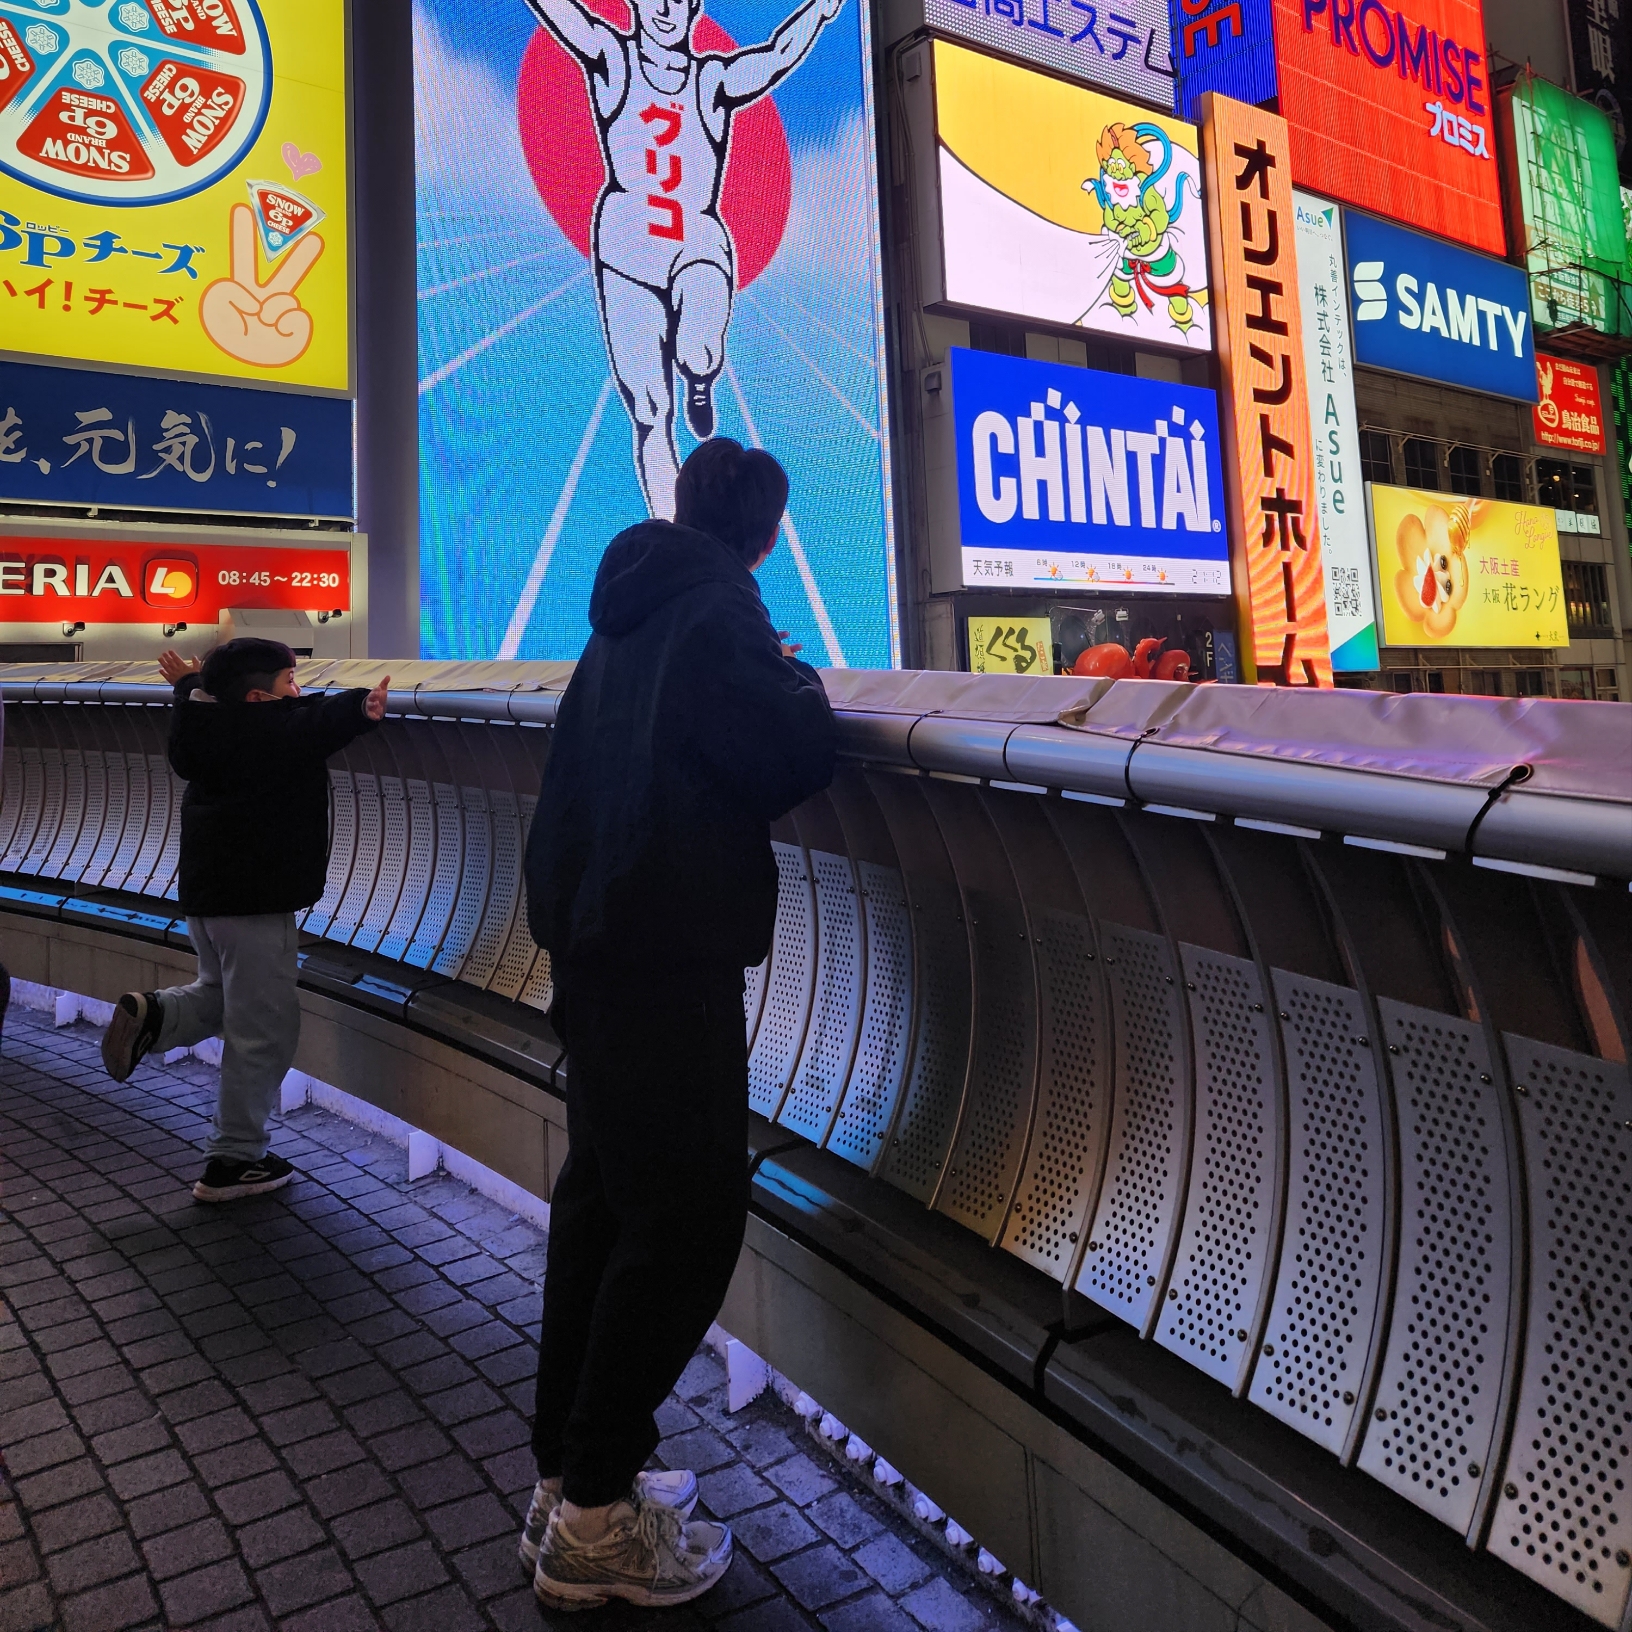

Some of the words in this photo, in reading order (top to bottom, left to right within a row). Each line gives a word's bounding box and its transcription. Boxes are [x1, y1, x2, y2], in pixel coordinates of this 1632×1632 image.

[143, 63, 177, 102] CHEESE
[159, 77, 200, 116] 6P
[61, 91, 115, 113] CHEESE
[183, 95, 206, 123] BRAND
[59, 106, 118, 139] 6P
[181, 86, 234, 155] SNOW
[1424, 101, 1490, 159] プロミス
[39, 137, 130, 173] SNOW
[66, 132, 107, 148] BRAND
[639, 101, 684, 242] グリコ
[266, 193, 305, 216] SNOW
[269, 209, 293, 226] 6P
[1296, 206, 1324, 228] Asue
[26, 221, 70, 234] ロッピー
[267, 220, 290, 234] CHEESE
[1314, 282, 1335, 384] 株式会社
[1328, 254, 1347, 377] 丸善インテックは、
[1396, 273, 1527, 358] SAMTY
[1233, 138, 1320, 688] オリエントホーム
[972, 387, 1212, 532] CHINTAI
[1324, 393, 1346, 515] Asue
[1315, 438, 1333, 555] に変わりました。
[1514, 510, 1539, 536] Hana
[972, 558, 1014, 578] 天気予報
[1479, 556, 1520, 577] 大阪土産
[1482, 587, 1501, 604] 大阪
[1502, 582, 1560, 613] 花ラング
[985, 625, 1037, 674] くくる
[1205, 631, 1214, 668] 2F
